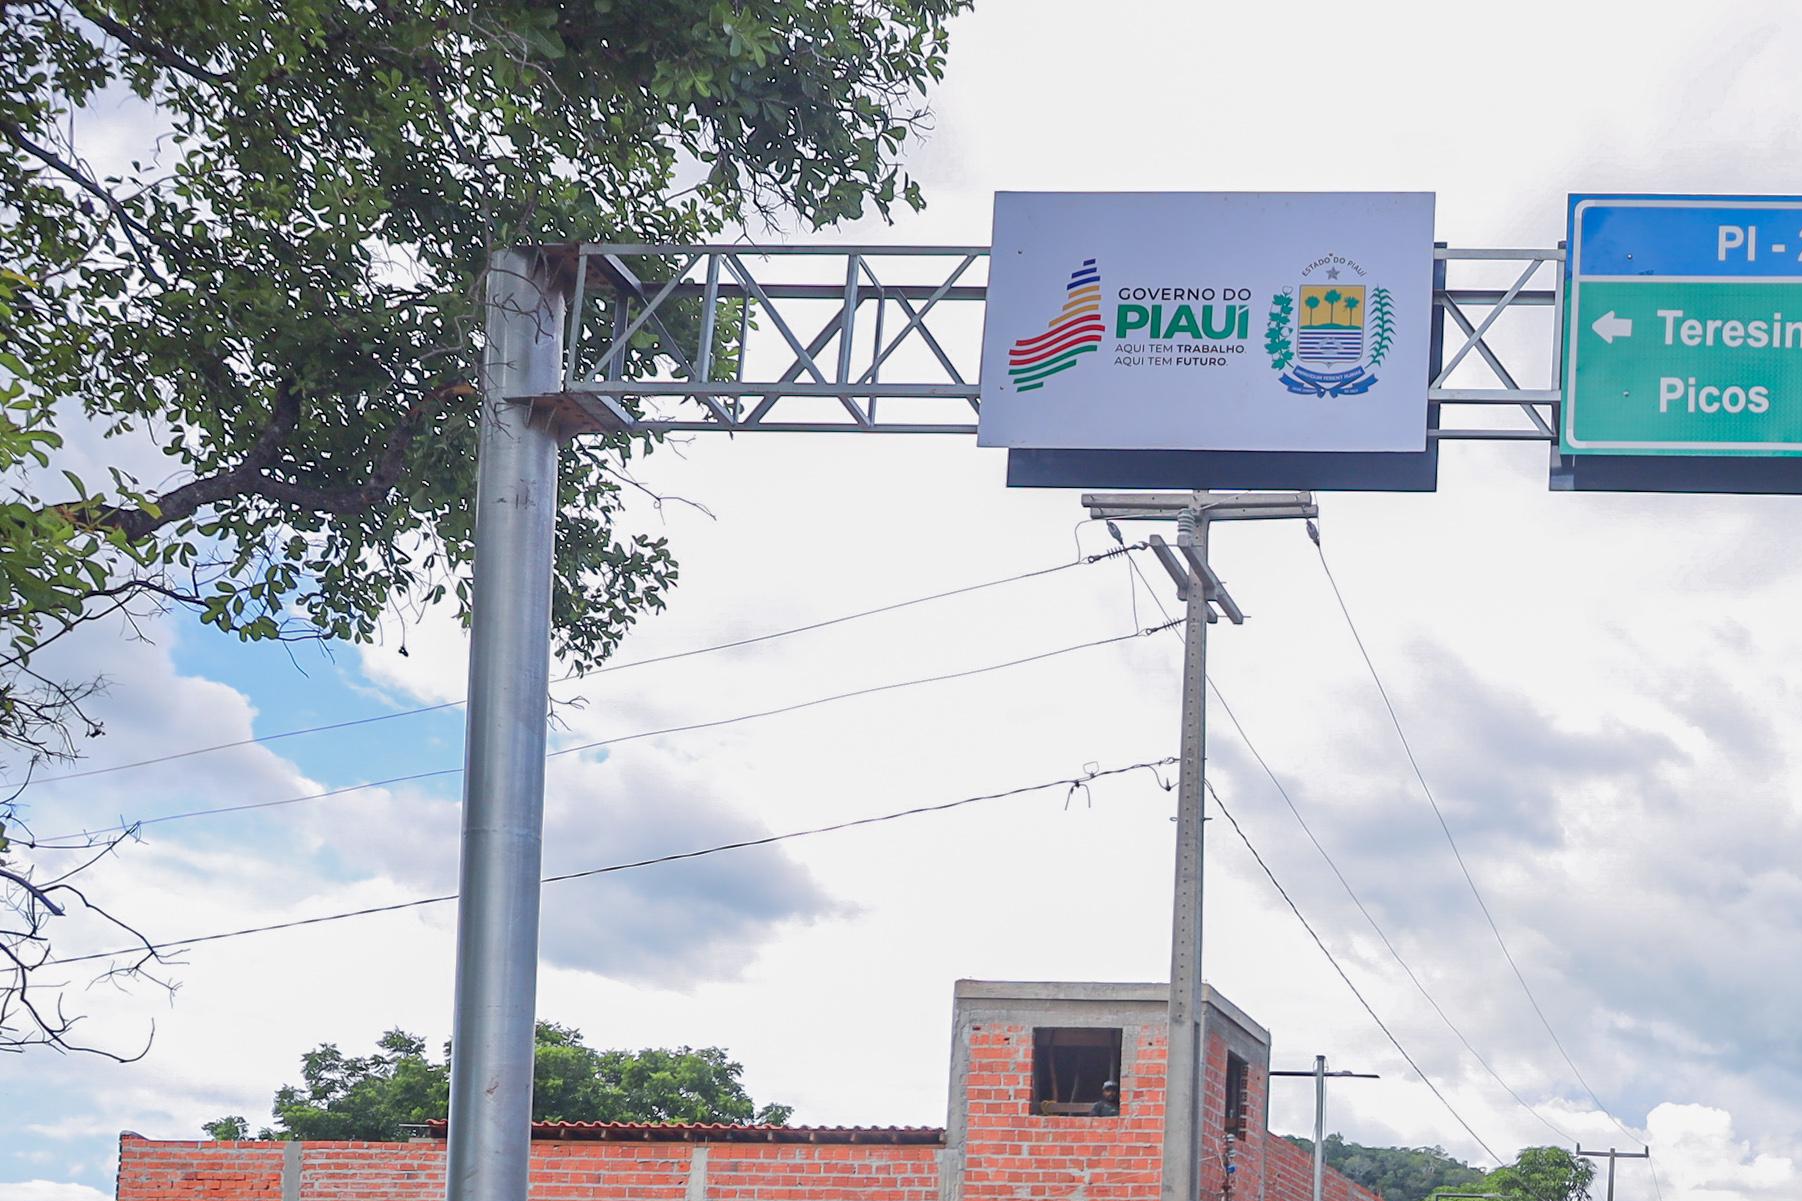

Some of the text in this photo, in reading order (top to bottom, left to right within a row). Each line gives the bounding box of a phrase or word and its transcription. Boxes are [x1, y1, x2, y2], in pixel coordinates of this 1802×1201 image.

[1717, 225, 1756, 261] PI
[1772, 245, 1785, 253] -
[1301, 256, 1367, 278] ESTADO DO PIAUÍ
[1118, 287, 1252, 301] GOVERNO DO
[1115, 304, 1249, 340] PIAUÍ
[1114, 343, 1248, 354] AQUI TEM TRABALHO.
[1113, 356, 1229, 367] AQUI TEM FUTURO.
[1658, 376, 1770, 414] Picos
